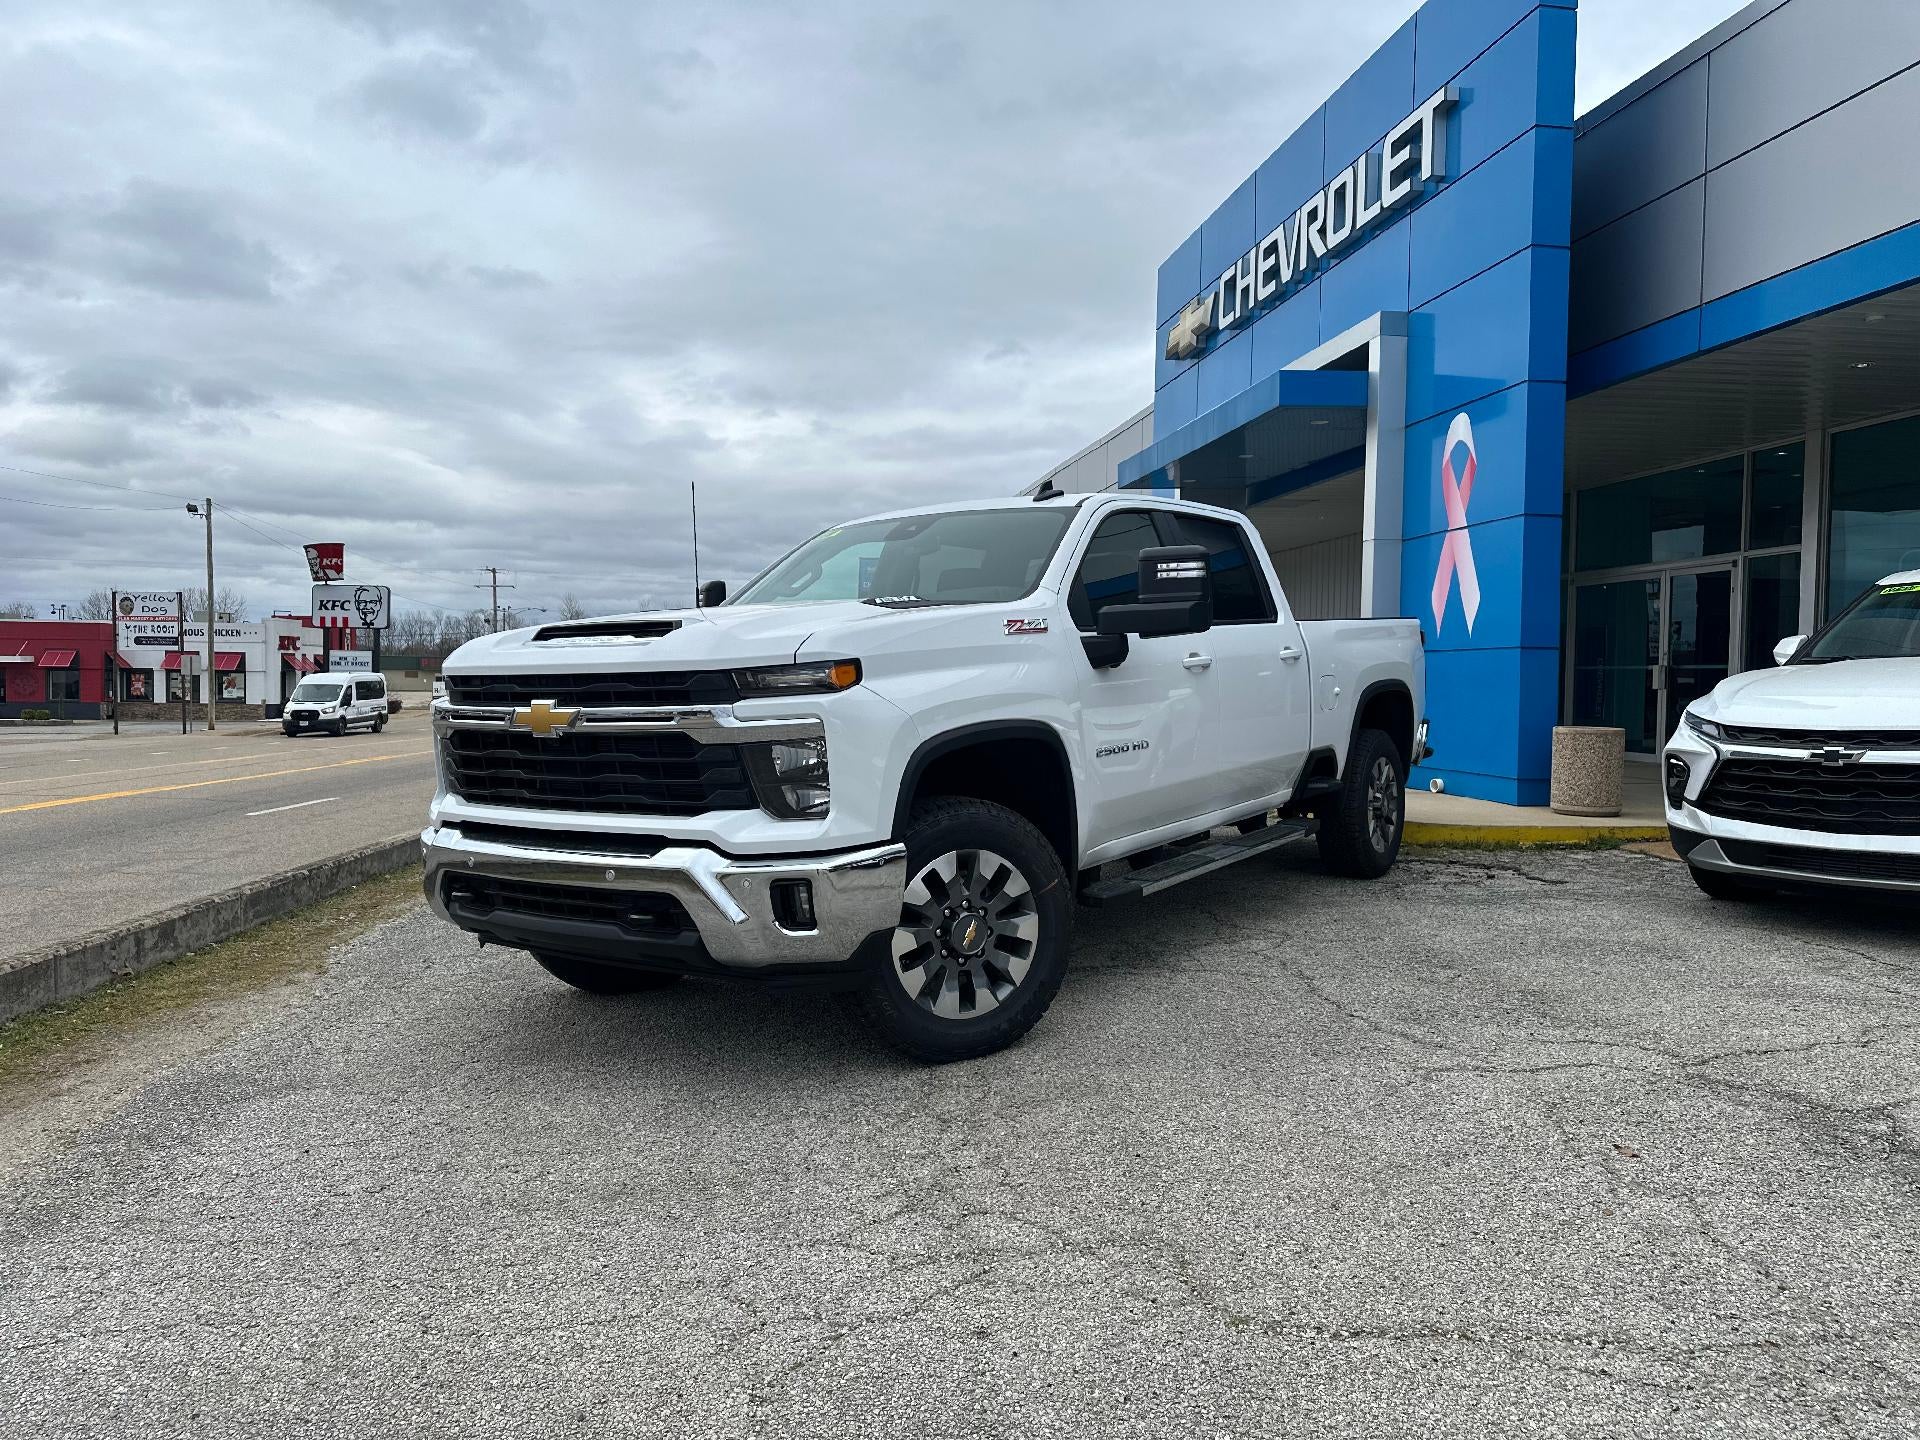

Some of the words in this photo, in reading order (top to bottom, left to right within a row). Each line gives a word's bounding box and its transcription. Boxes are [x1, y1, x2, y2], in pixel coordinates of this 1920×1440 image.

[1218, 86, 1459, 330] CHEVROLET
[322, 557, 343, 566] KFC
[132, 593, 176, 603] Yellow
[141, 605, 168, 616] Dog
[318, 599, 351, 611] KFC
[132, 624, 148, 634] THE
[150, 624, 175, 635] ROOST
[1003, 618, 1048, 635] Z71
[182, 628, 205, 637] MOUS
[213, 628, 241, 637] HICKEN
[278, 635, 301, 651] KFC
[1095, 743, 1130, 758] 2500
[1132, 739, 1150, 751] HD
